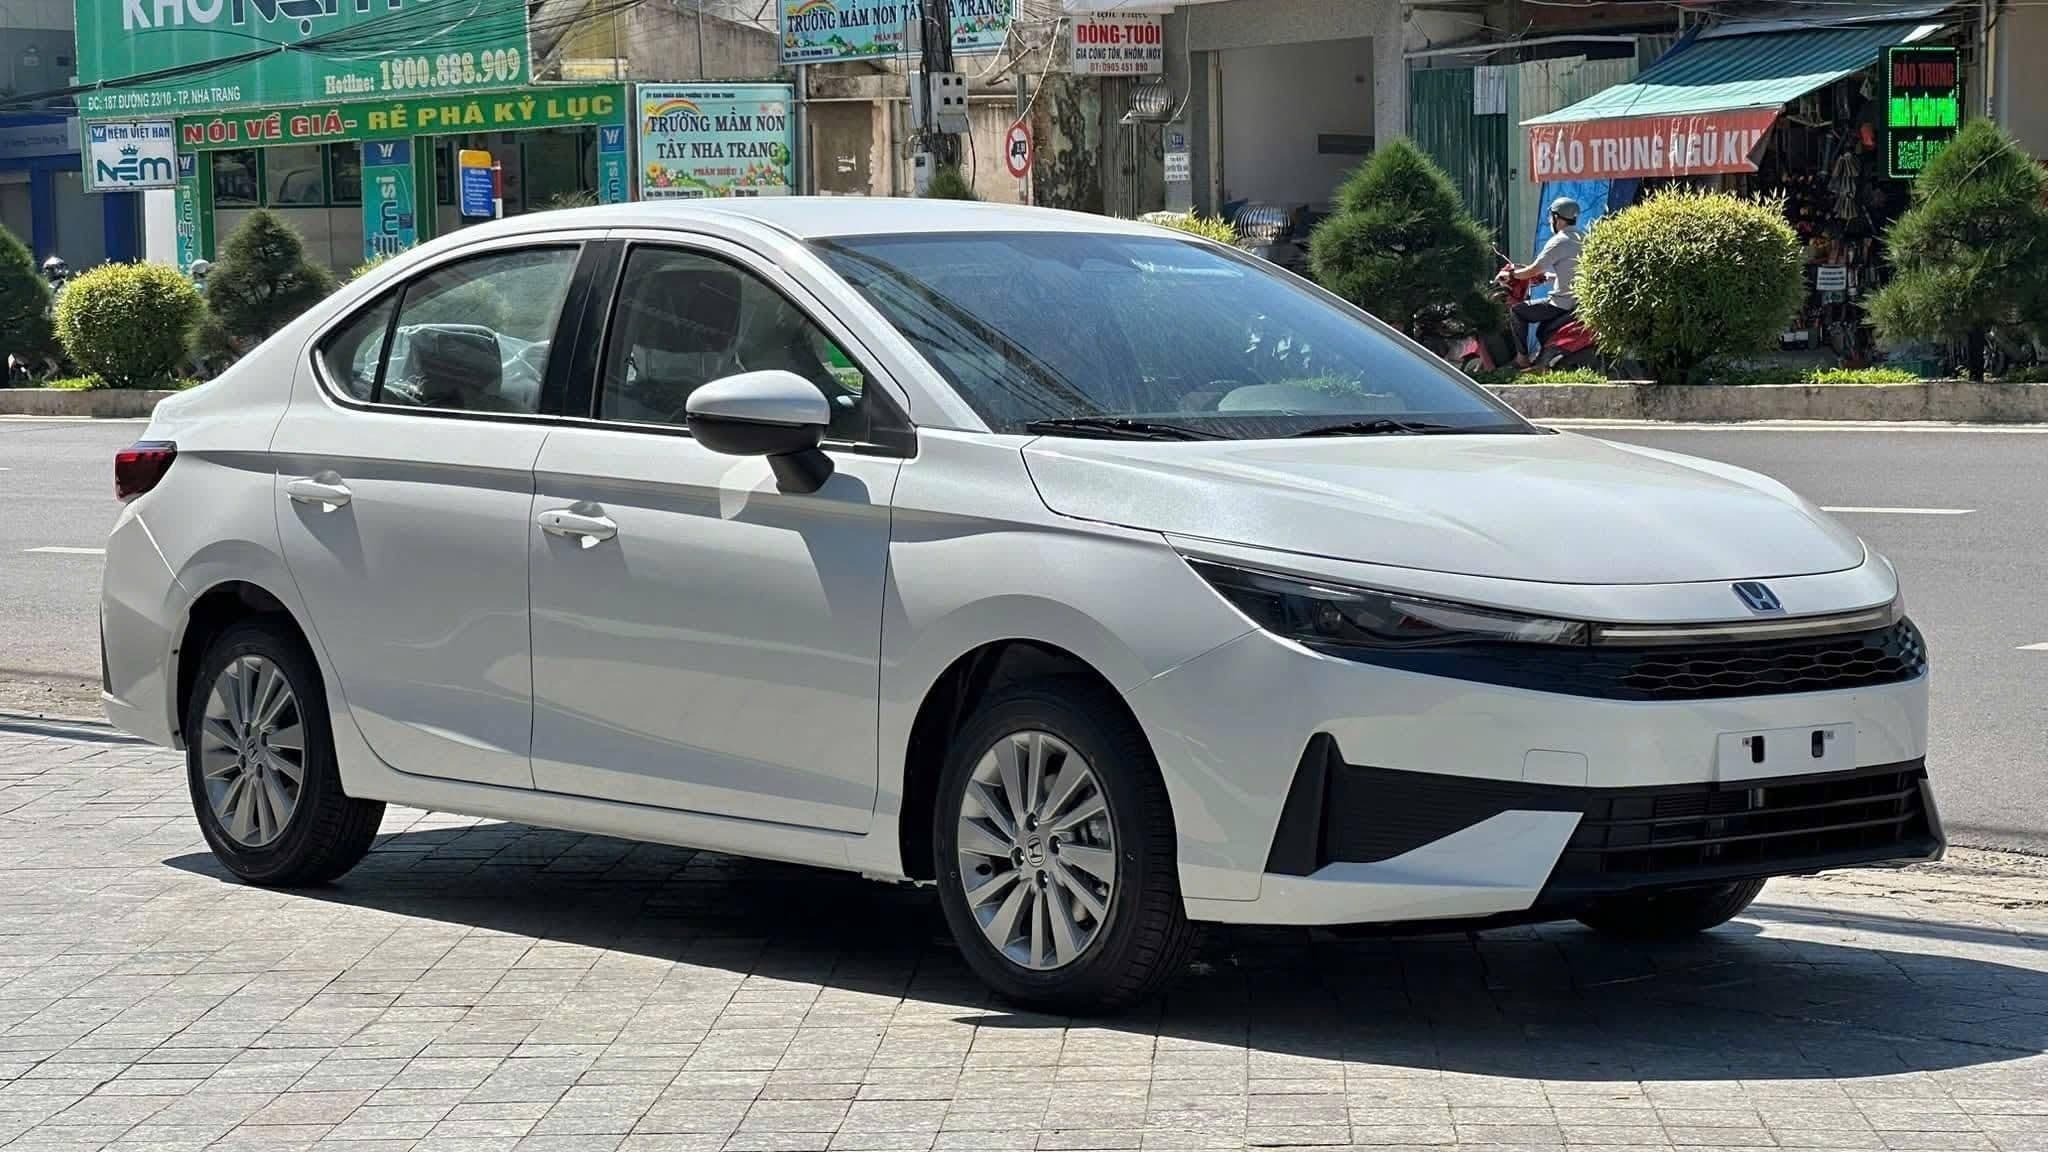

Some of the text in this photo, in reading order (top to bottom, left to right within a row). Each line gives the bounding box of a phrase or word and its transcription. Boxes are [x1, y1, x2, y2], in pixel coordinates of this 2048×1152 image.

[787, 8, 836, 32] TRƯỜNG
[840, 0, 870, 28] MẦM
[874, 5, 897, 24] NON
[1076, 48, 1087, 60] GIA
[325, 48, 520, 94] Hotline: 1800.888.909
[104, 95, 117, 109] 187
[118, 91, 149, 109] ĐƯỜNG
[151, 91, 172, 107] 23/10
[178, 90, 190, 105] TP.
[191, 90, 210, 104] NHA
[211, 86, 241, 102] TRANG
[183, 118, 238, 144] NÓI
[244, 112, 281, 140] VỀ
[368, 103, 409, 130] RẺ
[417, 101, 484, 127] PHÁ
[494, 95, 537, 123] KỶ
[547, 95, 614, 124] LỤC
[648, 106, 785, 132] TRƯỜNG MẦM NON
[656, 138, 778, 159] TÂY NHA TRANG
[1590, 134, 1664, 173] TRUNG
[1670, 126, 1717, 169] NGŨ
